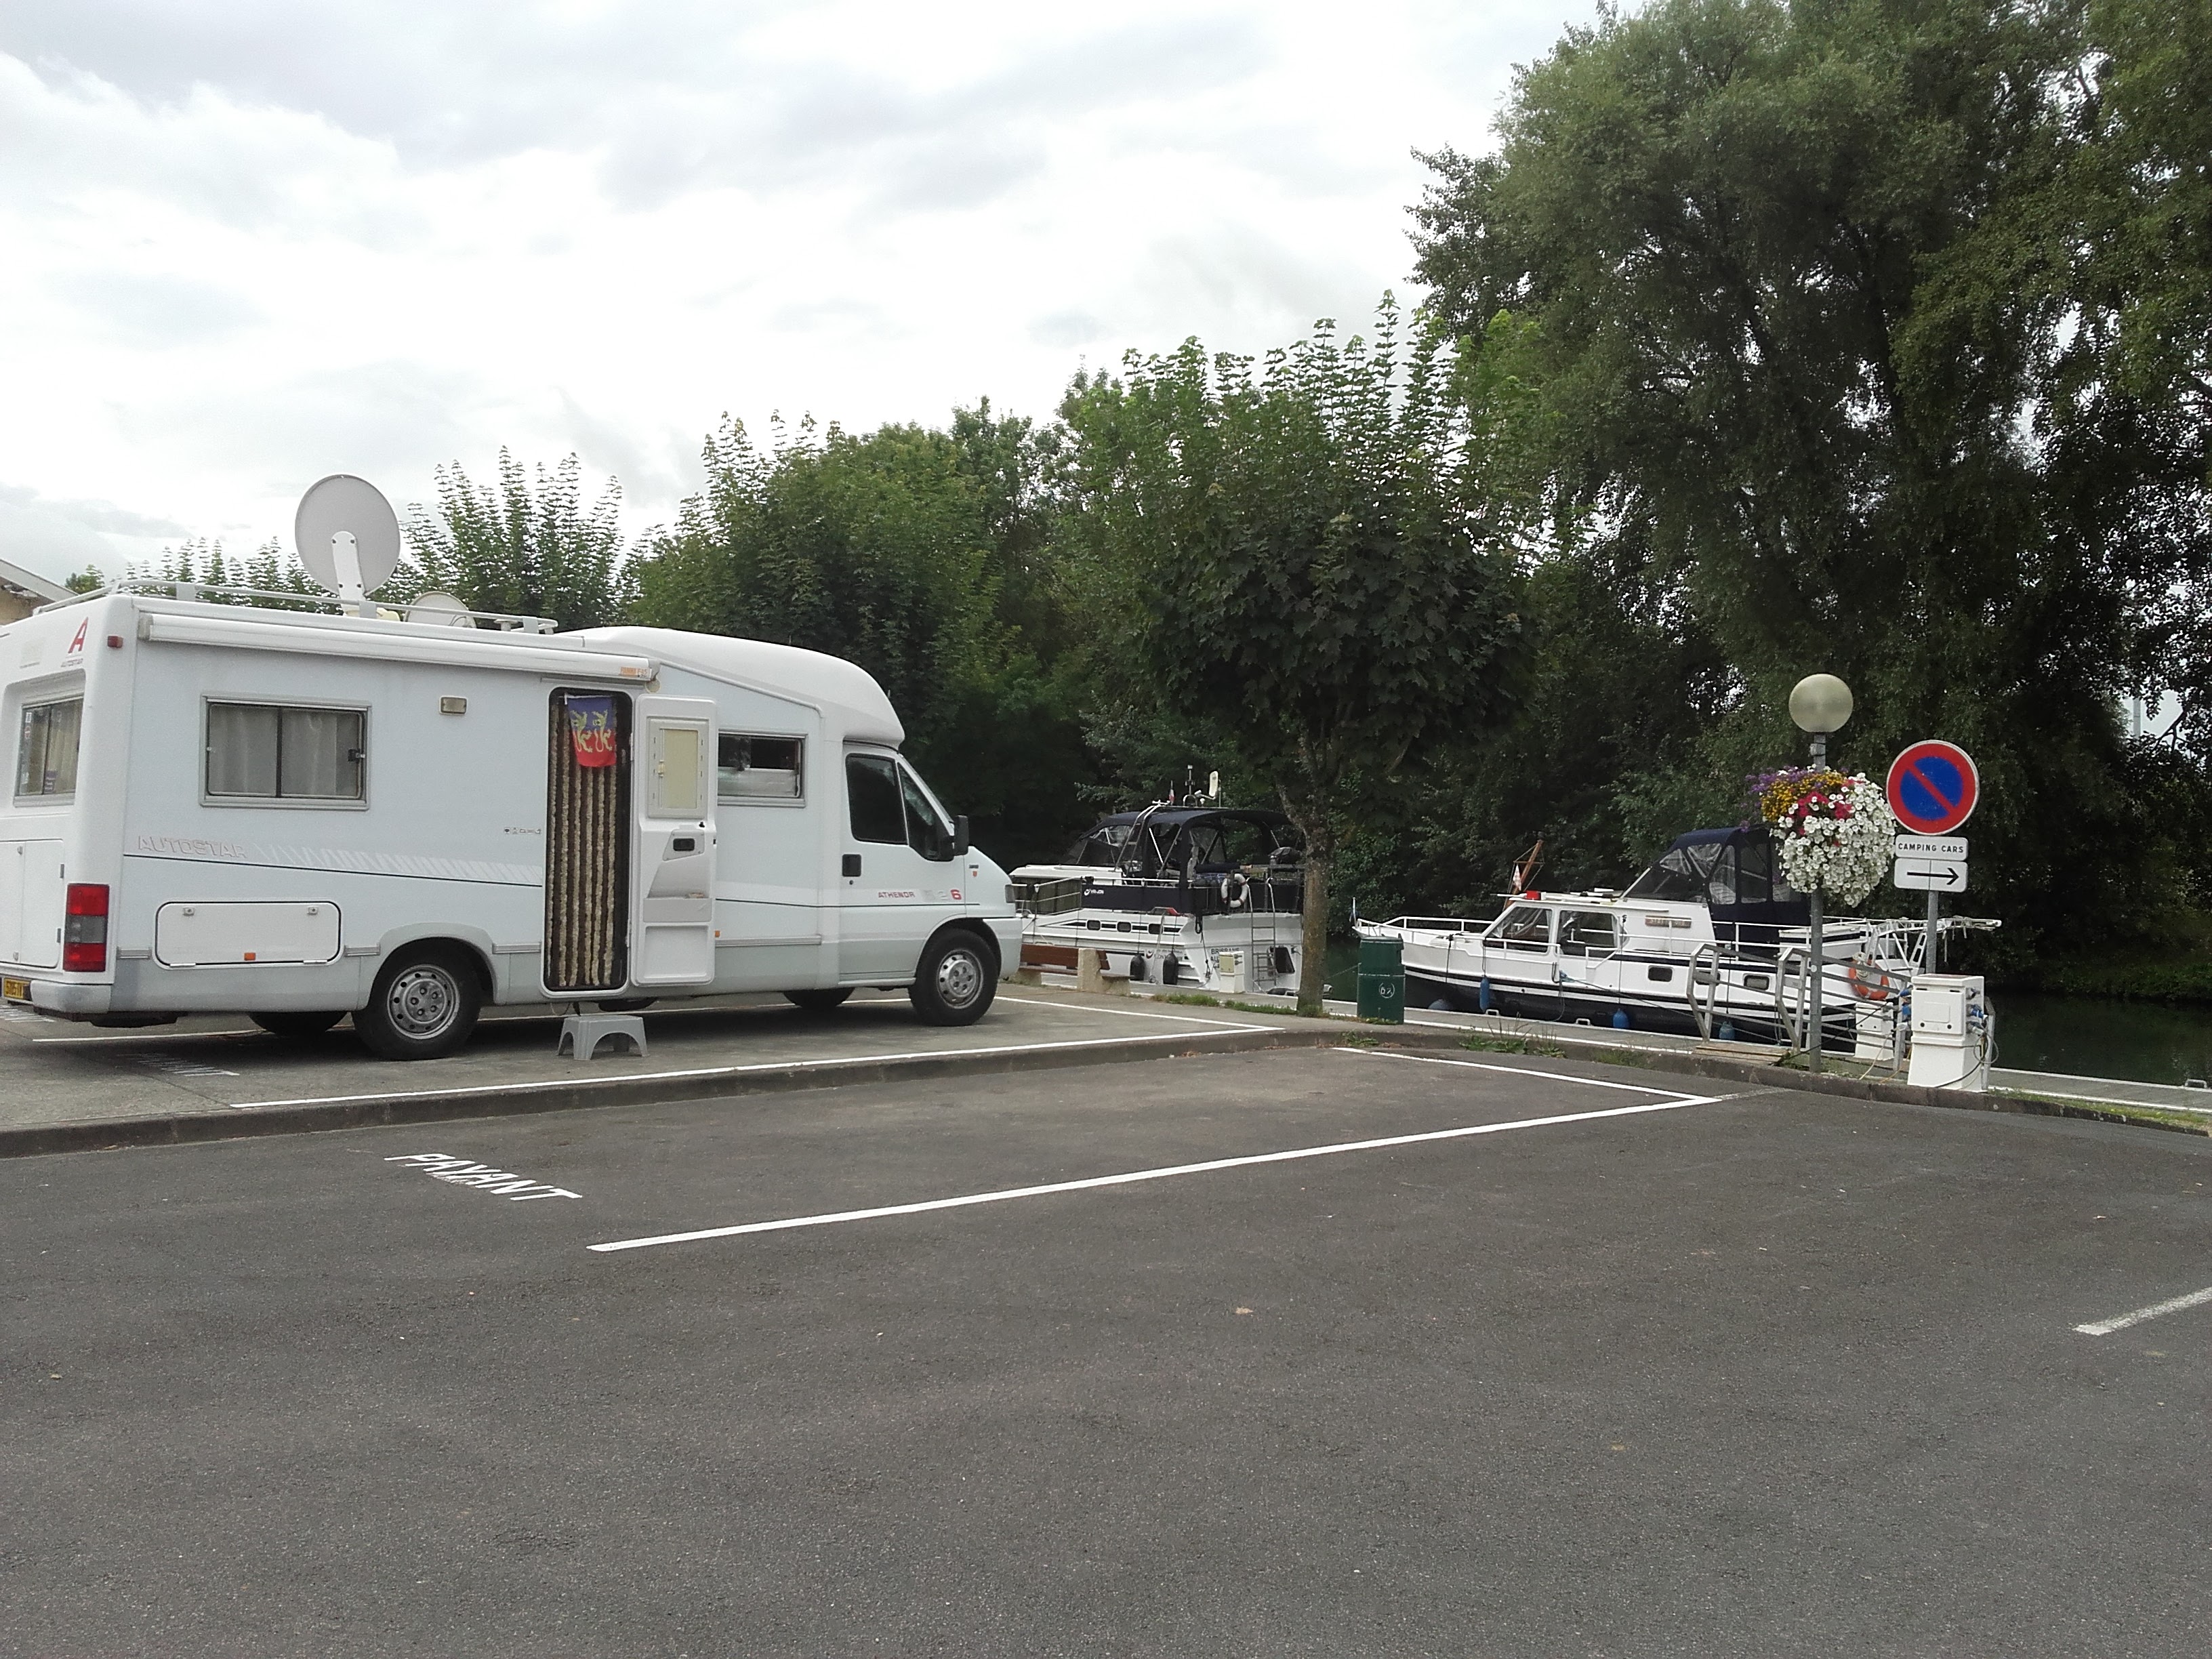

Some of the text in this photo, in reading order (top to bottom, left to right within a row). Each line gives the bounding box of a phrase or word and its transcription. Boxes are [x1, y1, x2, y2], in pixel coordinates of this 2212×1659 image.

[138, 835, 248, 859] AUTOSTAR
[1898, 842, 1964, 853] CAMPING CARS
[384, 1153, 583, 1201] PAYANT
